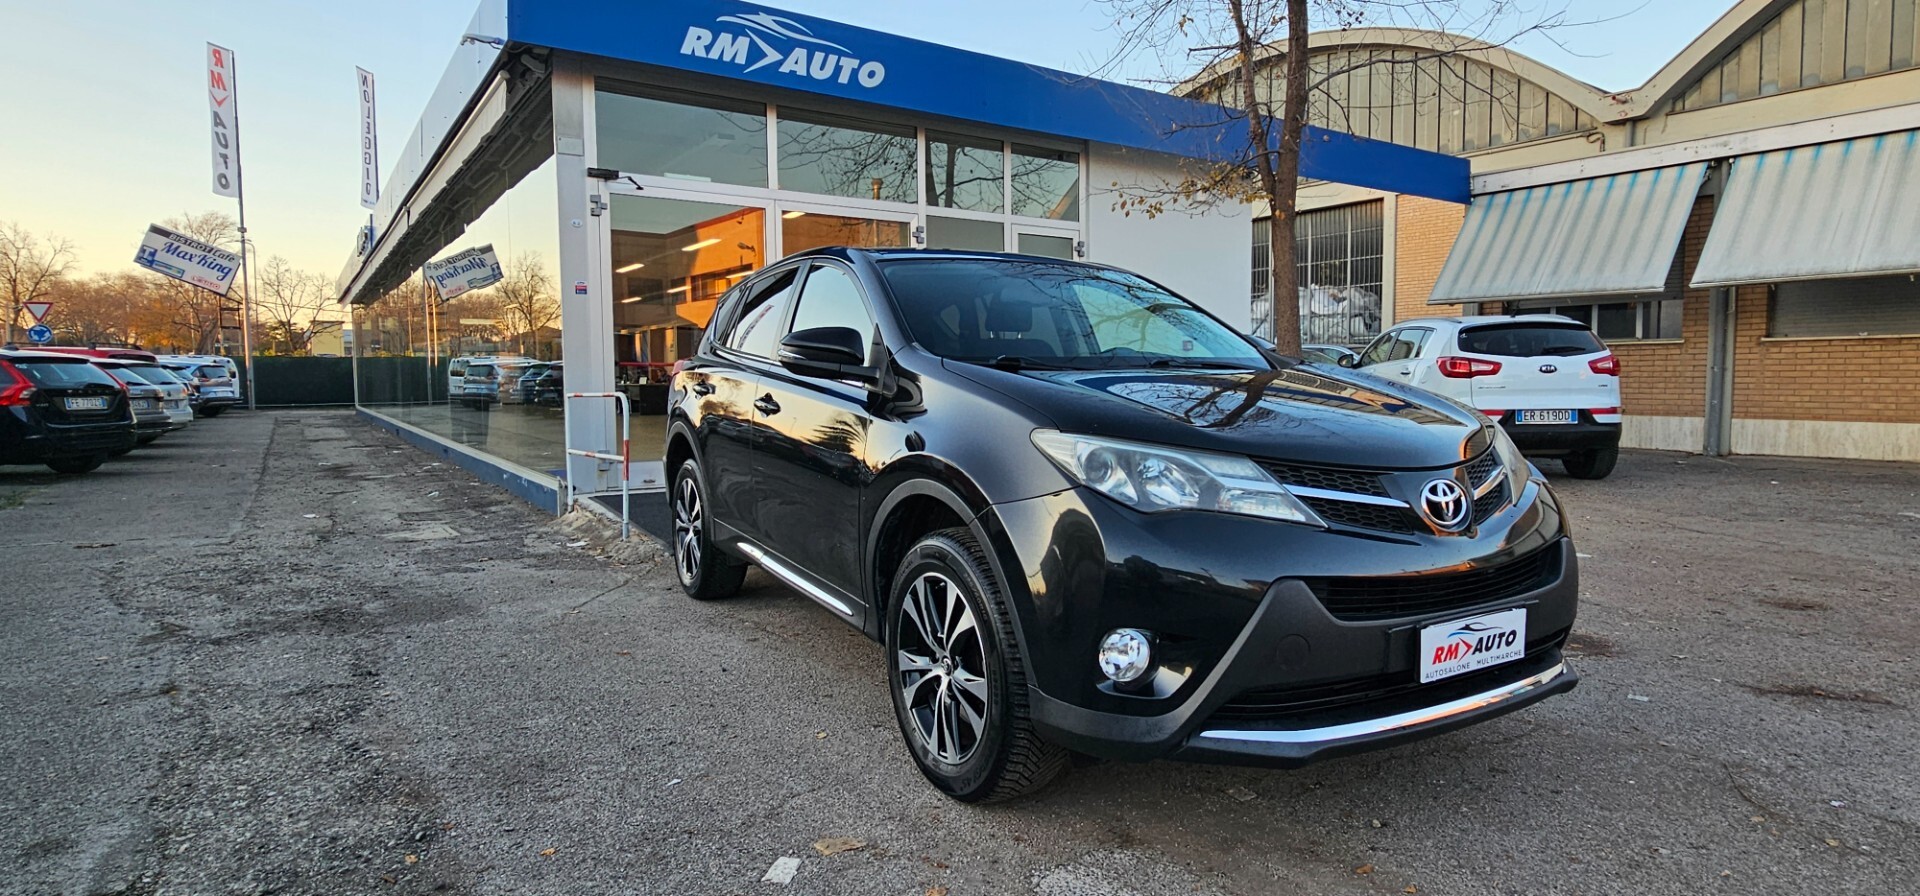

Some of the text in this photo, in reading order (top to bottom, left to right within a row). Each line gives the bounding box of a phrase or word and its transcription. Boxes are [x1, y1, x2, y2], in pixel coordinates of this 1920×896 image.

[680, 26, 885, 88] RM AUTO
[168, 233, 235, 263] BISTROT Café
[1523, 409, 1570, 421] ER 619DD
[1432, 629, 1518, 665] RM AUTO
[1425, 649, 1522, 679] AUTOSALONE MULTIMARCHE
